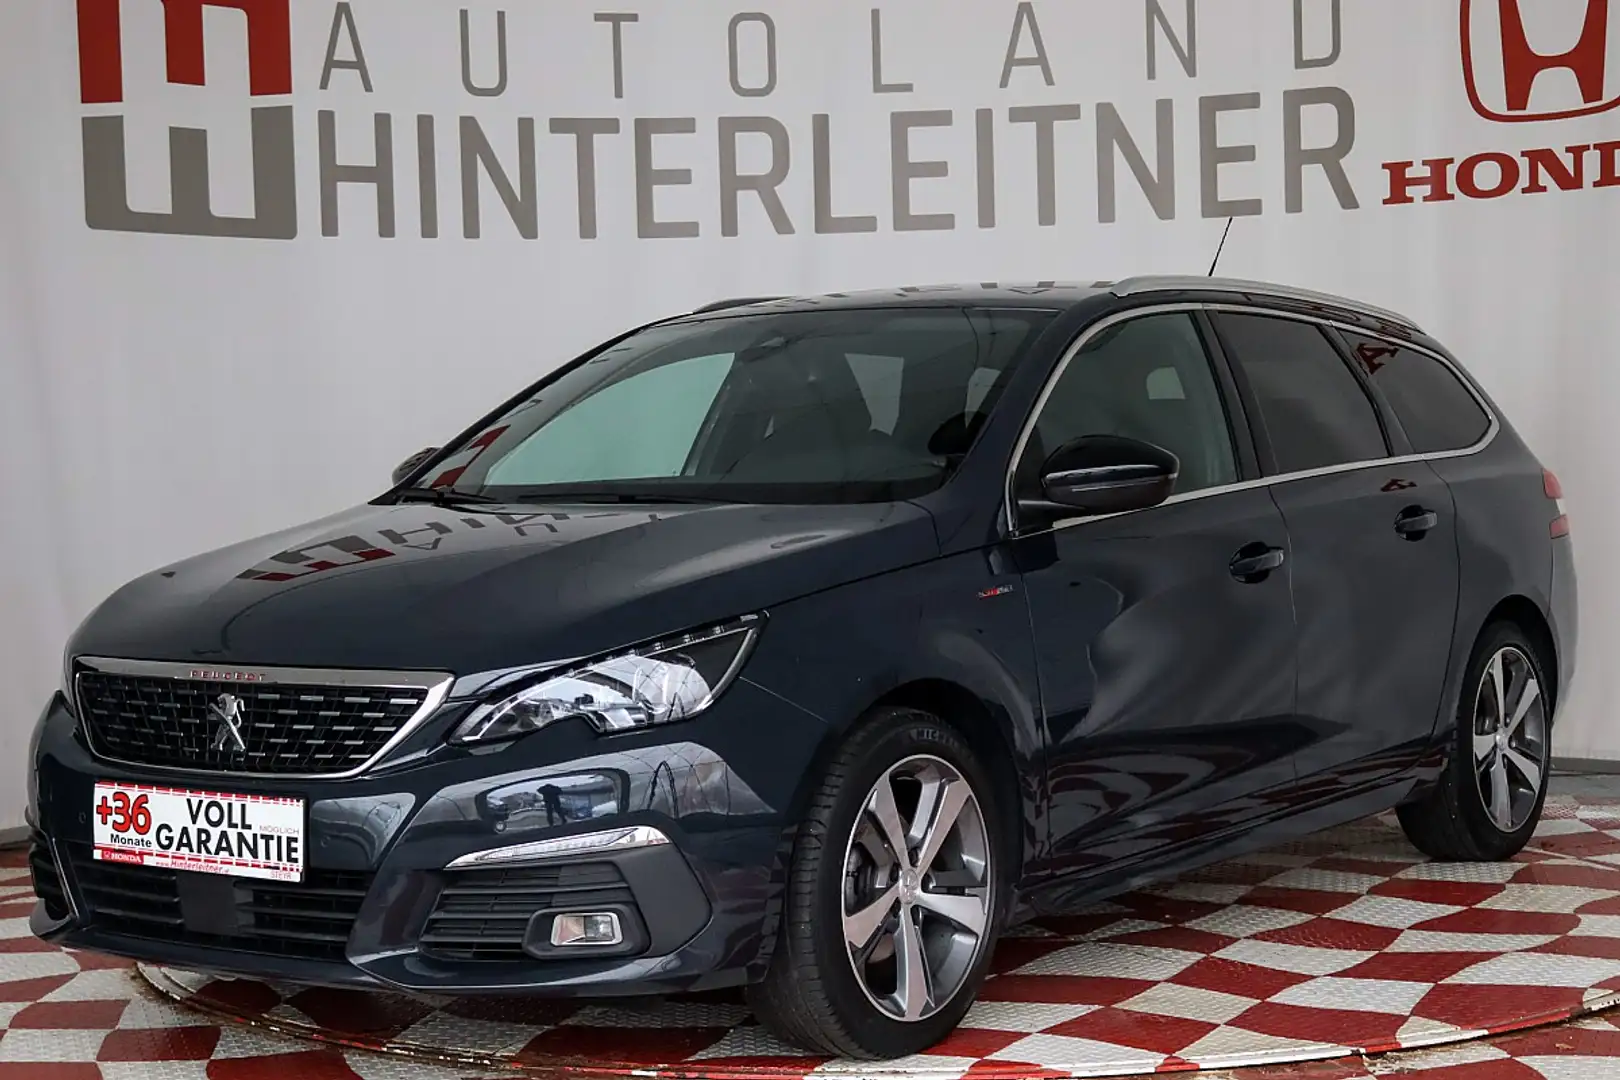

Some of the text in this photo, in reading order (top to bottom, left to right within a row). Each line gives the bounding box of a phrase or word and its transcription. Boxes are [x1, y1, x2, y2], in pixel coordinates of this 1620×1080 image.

[317, 86, 1360, 240] HINTERLEITNER
[190, 670, 268, 681] PEUGEOT
[96, 791, 152, 835] +36
[186, 797, 252, 830] VOLL
[110, 833, 152, 848] Monate
[155, 823, 299, 864] GARANTIE
[111, 852, 142, 863] HONDA
